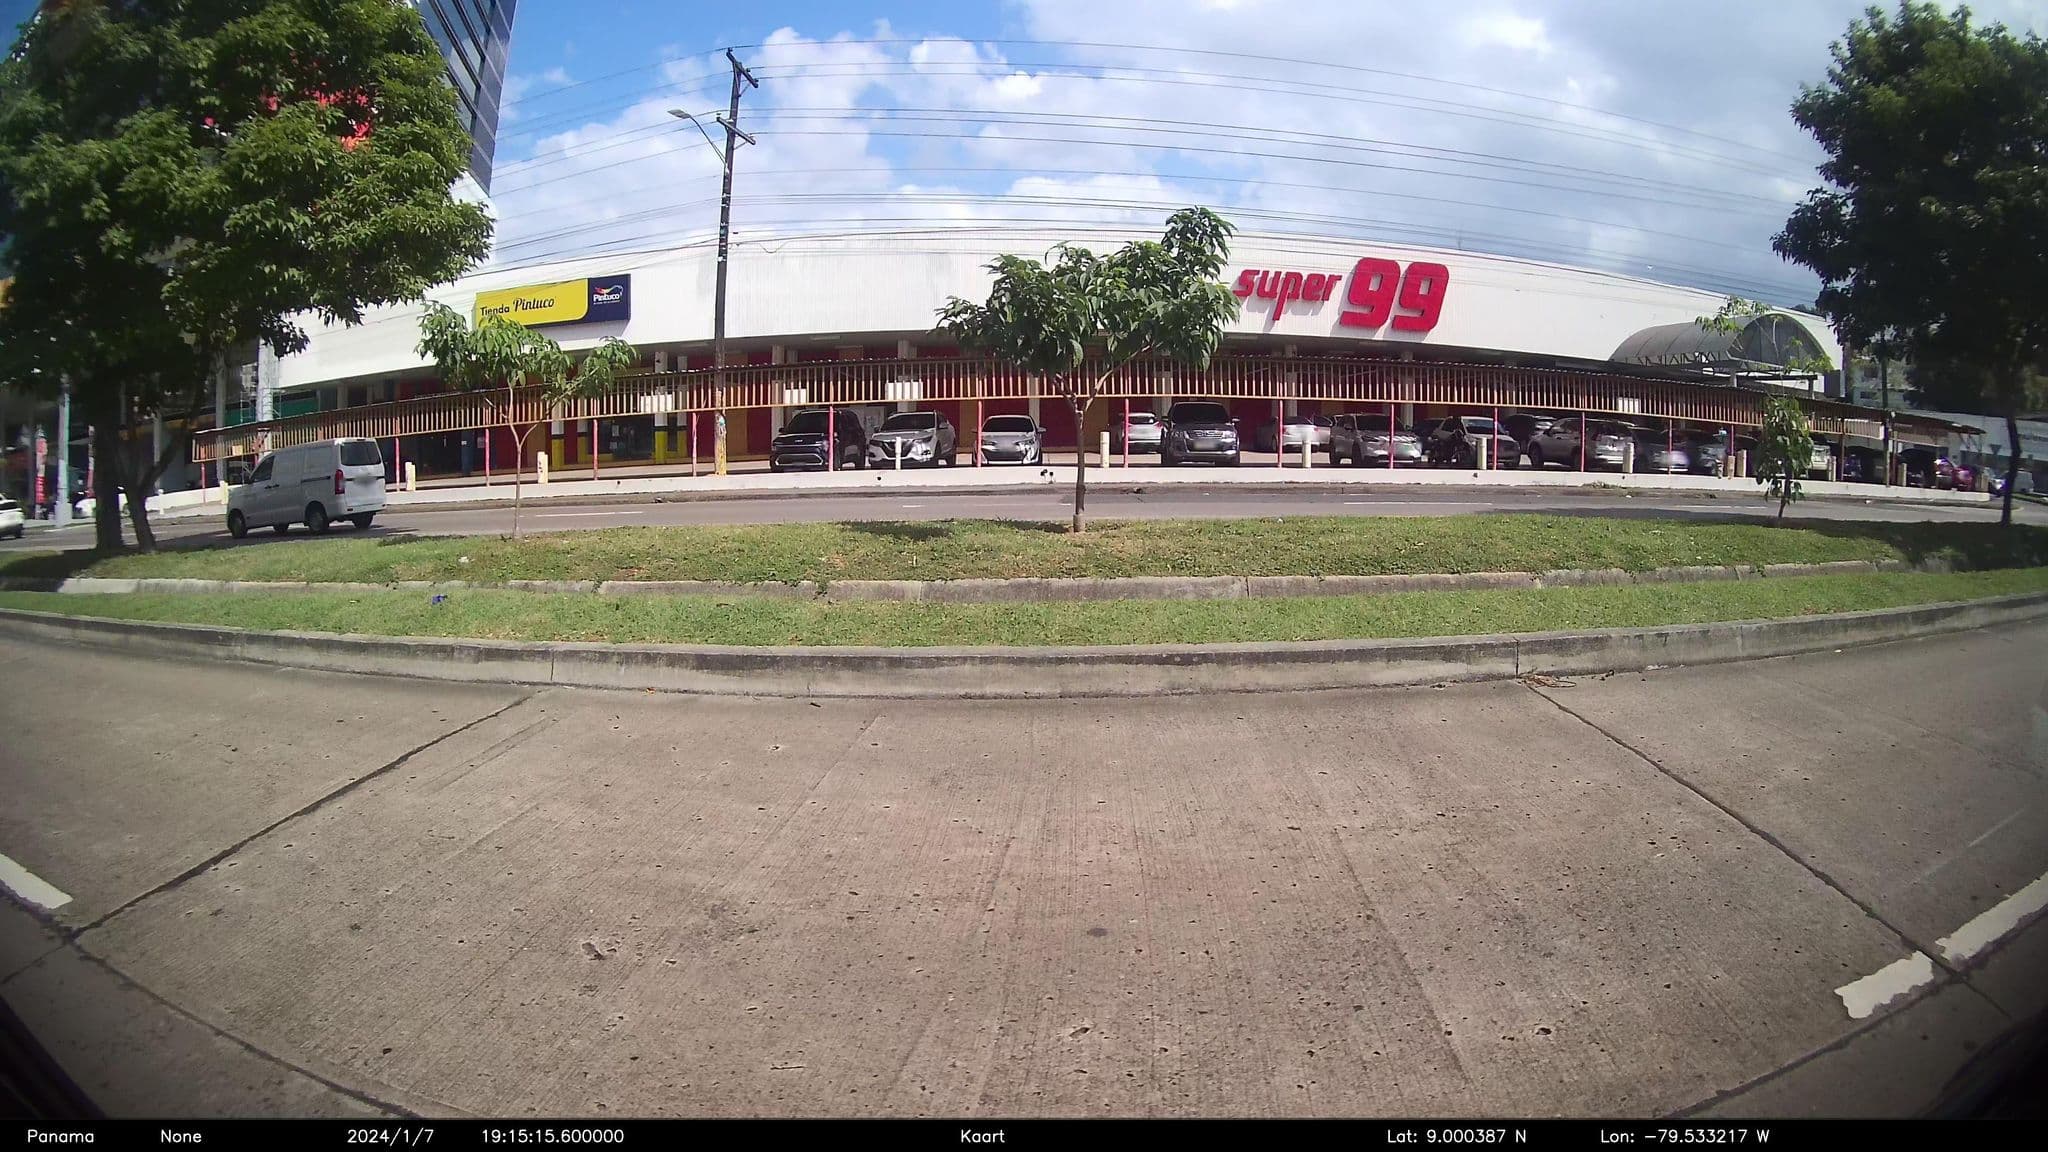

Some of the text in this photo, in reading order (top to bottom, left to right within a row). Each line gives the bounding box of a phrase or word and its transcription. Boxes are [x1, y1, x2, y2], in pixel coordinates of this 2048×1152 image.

[593, 293, 620, 302] Pintuco
[1233, 257, 1449, 331] super 99
[480, 297, 555, 316] Tienda Pintuco
